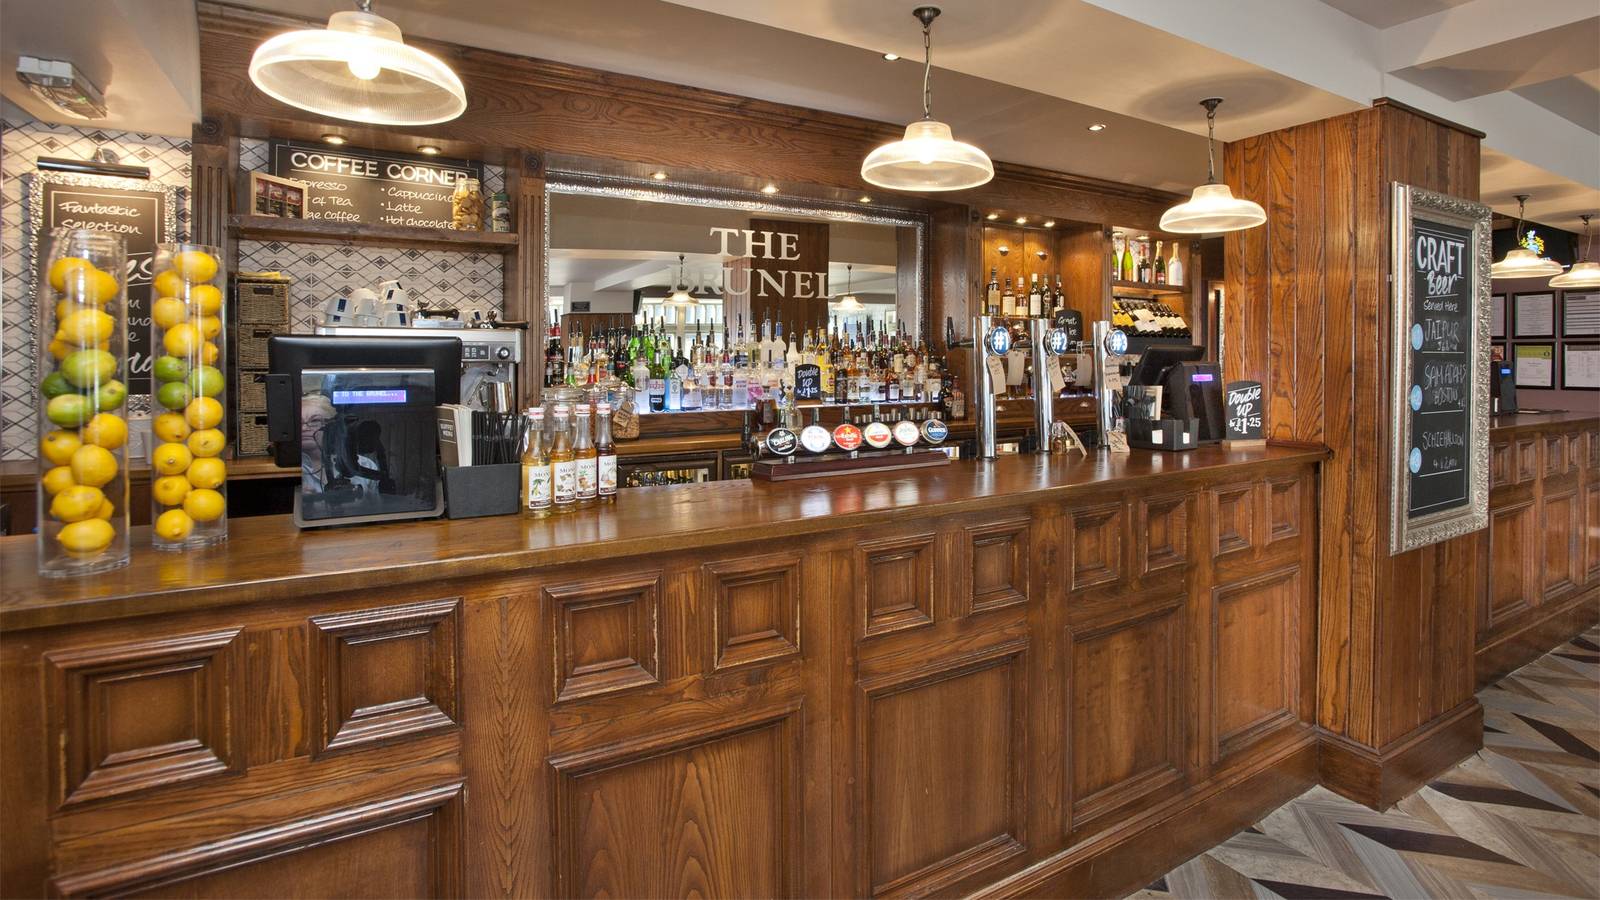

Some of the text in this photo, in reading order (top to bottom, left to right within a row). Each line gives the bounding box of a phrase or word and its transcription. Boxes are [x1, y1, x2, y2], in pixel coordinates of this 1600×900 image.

[291, 152, 379, 177] COFFEE
[58, 201, 141, 217] Fantastic
[312, 196, 354, 208] of Tea
[386, 201, 424, 214] Latte
[61, 218, 143, 235] Selection
[324, 210, 361, 223] Coffee
[386, 215, 405, 225] Hot
[709, 226, 801, 261] THE
[1416, 235, 1465, 276] CRAFT
[667, 264, 838, 300] BRUNEL
[1426, 270, 1458, 296] Beer
[993, 327, 1009, 353] #1
[1424, 318, 1460, 342] JAIPUR
[1051, 329, 1068, 354] #2
[1111, 330, 1128, 354] #3
[1228, 386, 1262, 407] Double
[1236, 402, 1254, 417] UP
[1233, 417, 1262, 434] £1.25
